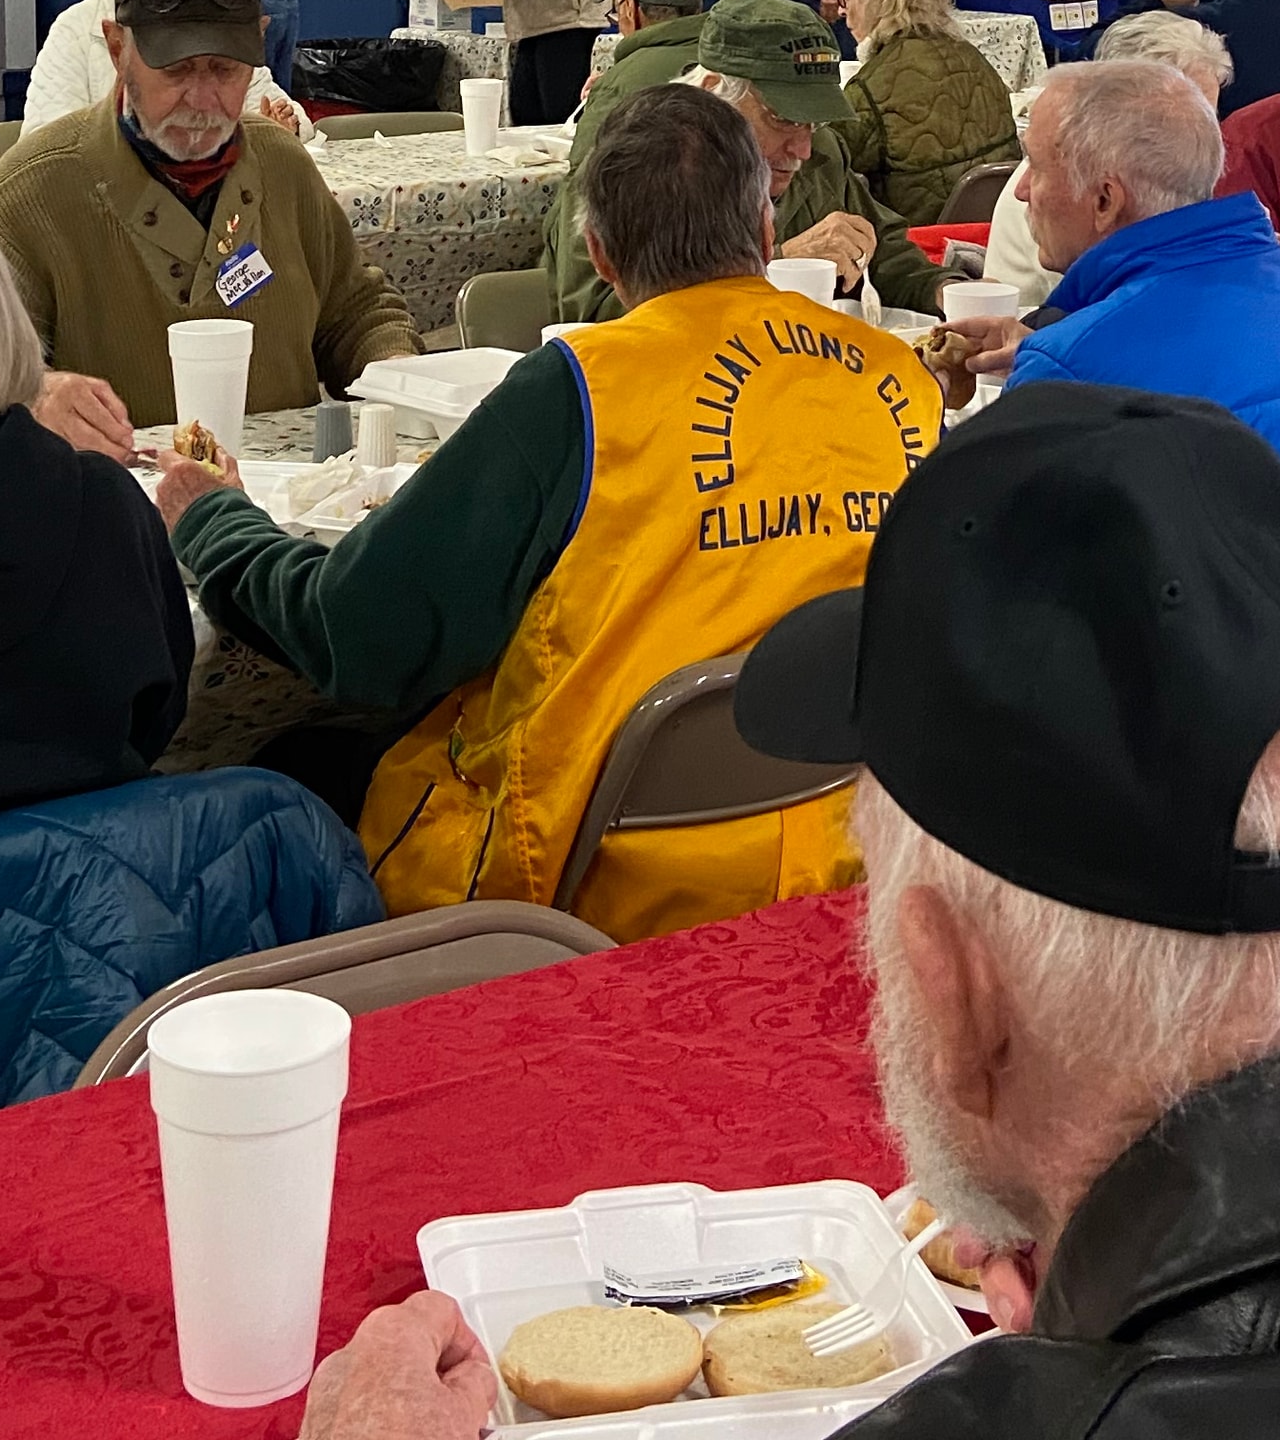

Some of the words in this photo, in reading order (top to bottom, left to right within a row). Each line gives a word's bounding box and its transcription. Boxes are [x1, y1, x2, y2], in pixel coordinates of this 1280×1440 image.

[219, 263, 250, 292] George
[691, 334, 761, 492] ELLIJAY
[763, 319, 866, 375] LIONS
[699, 492, 832, 551] ELLIJAY,
